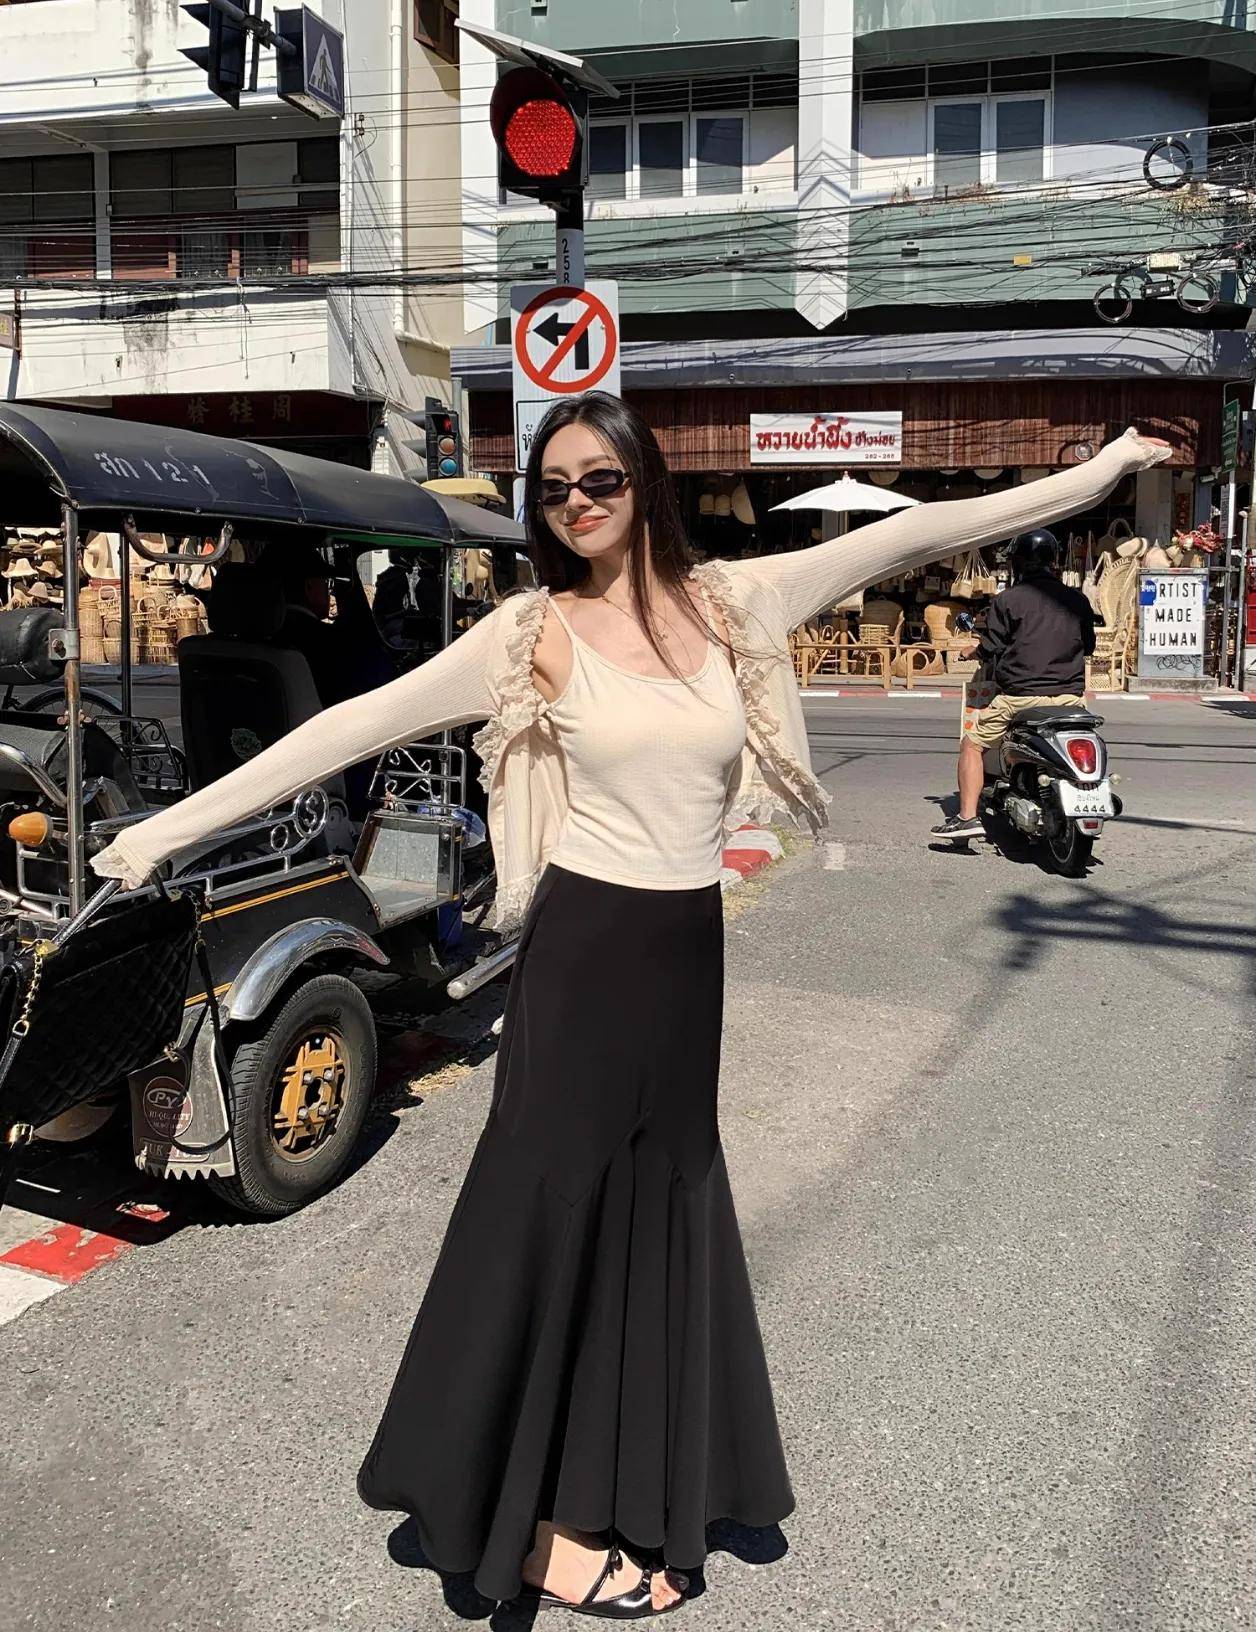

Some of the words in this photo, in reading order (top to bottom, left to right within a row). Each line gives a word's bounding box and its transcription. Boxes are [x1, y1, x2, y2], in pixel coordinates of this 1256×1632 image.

[1159, 582, 1198, 598] RTIST
[1155, 608, 1192, 623] MADE
[1149, 632, 1197, 647] HUMAN
[1074, 804, 1105, 813] 4444
